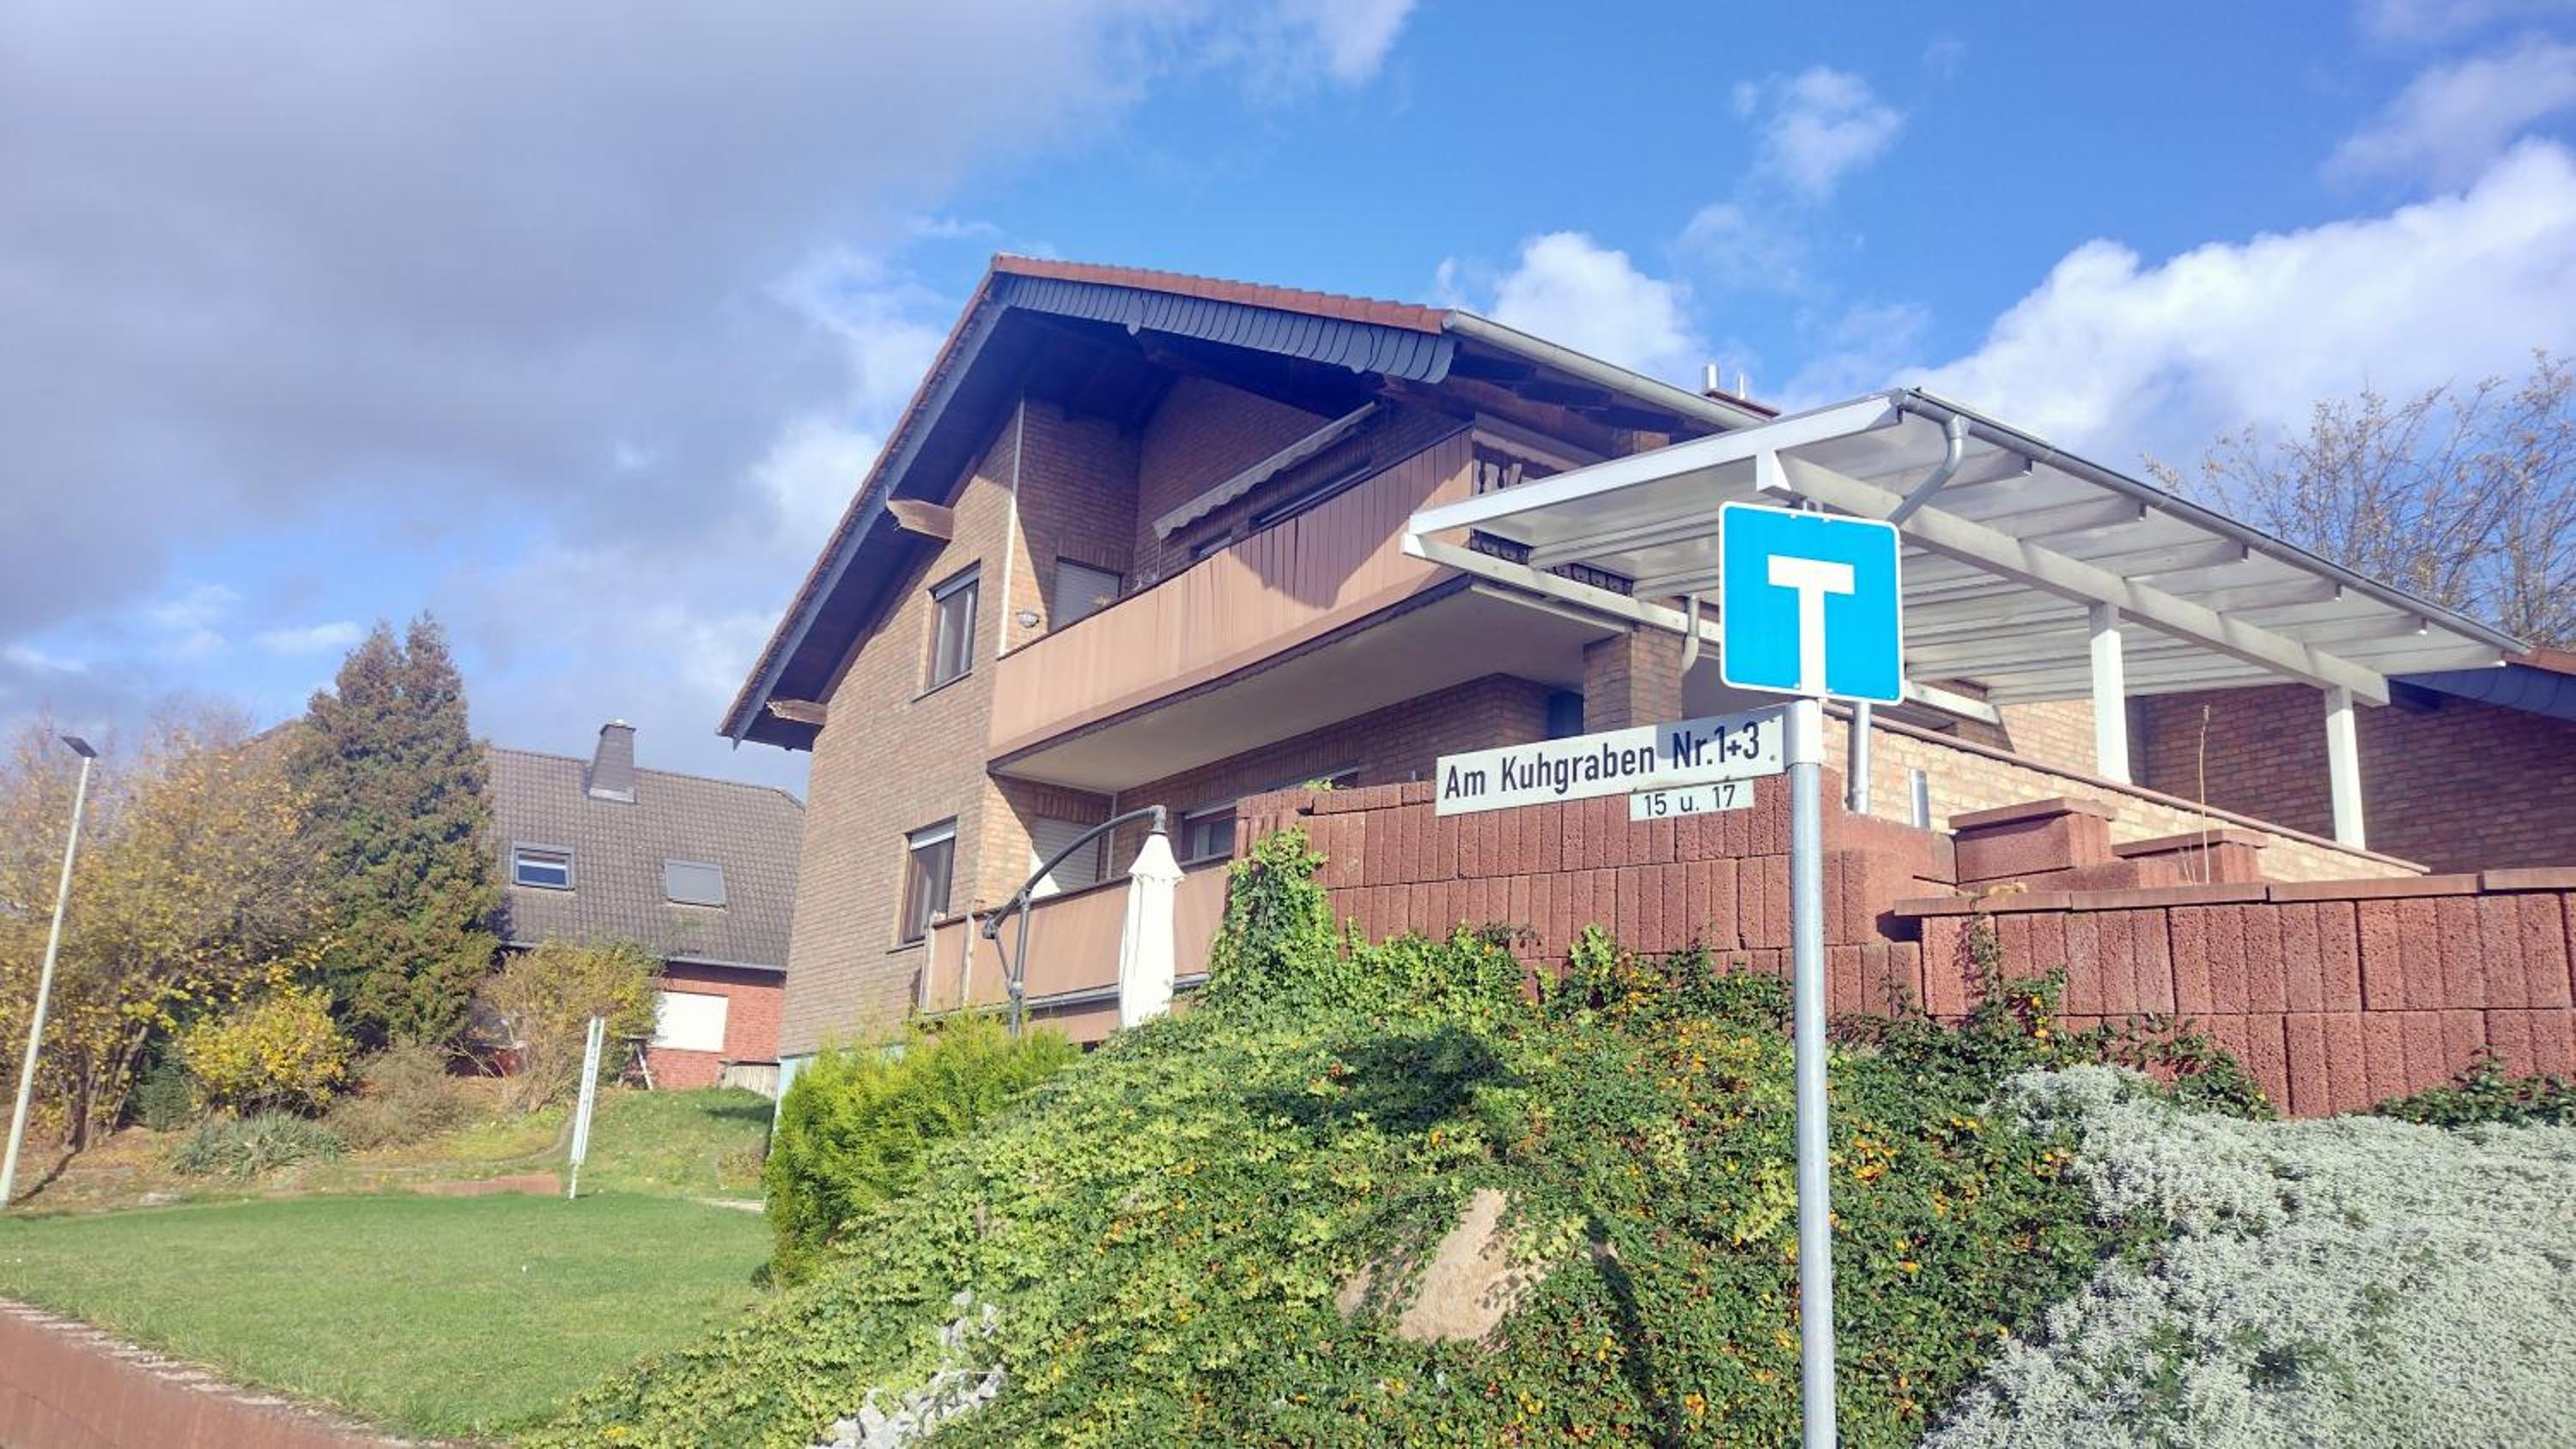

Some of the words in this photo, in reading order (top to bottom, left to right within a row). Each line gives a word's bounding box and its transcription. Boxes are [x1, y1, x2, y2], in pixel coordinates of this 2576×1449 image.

[1444, 765, 1486, 800] Am
[1500, 743, 1656, 795] Kuhgraben
[1643, 793, 1668, 816] 15
[1680, 797, 1700, 813] u.
[1713, 784, 1736, 809] 17
